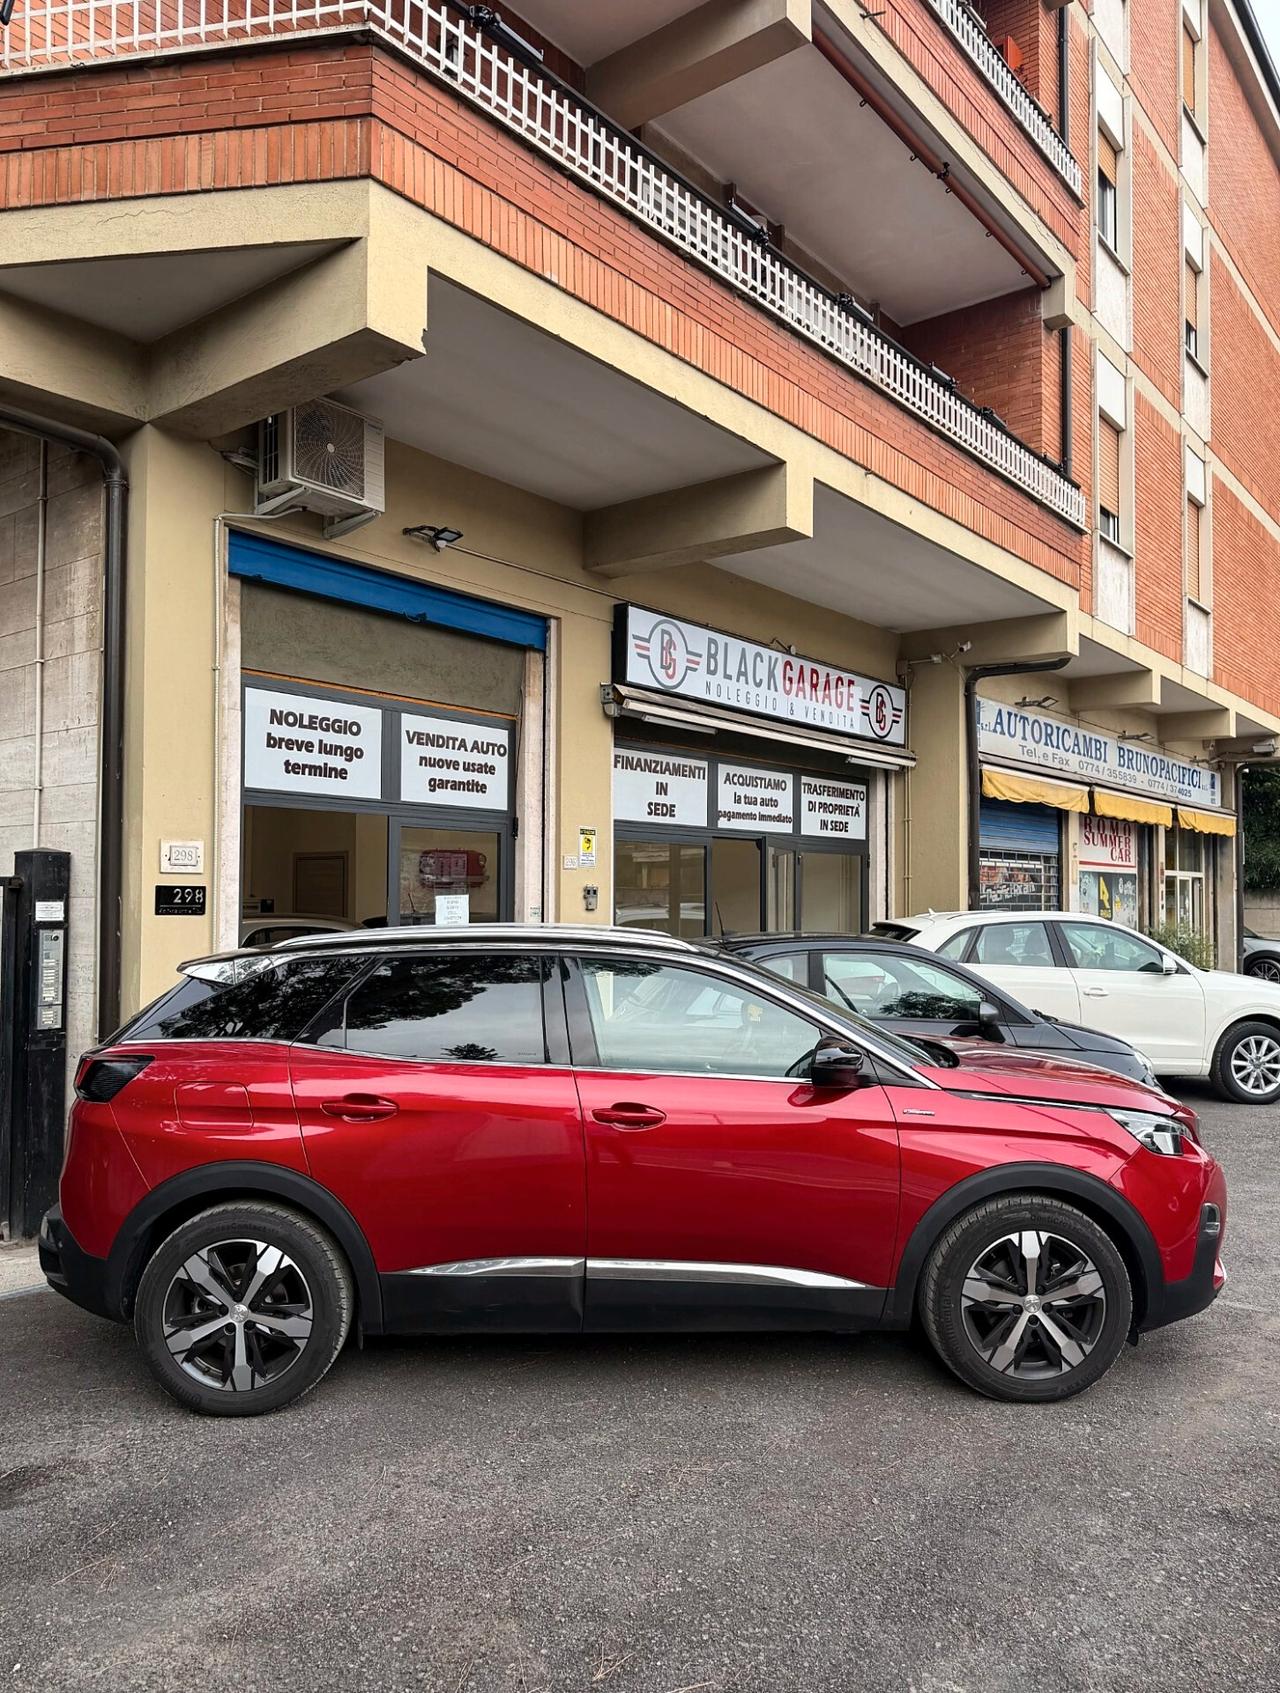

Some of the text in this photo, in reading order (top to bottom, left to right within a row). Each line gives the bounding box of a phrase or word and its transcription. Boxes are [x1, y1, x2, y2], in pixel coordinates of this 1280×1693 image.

[705, 681, 855, 729] NOLEGGIO & VENDITA
[269, 708, 361, 737] NOLEGGIO
[405, 729, 508, 757] VENDITA AUTO
[993, 708, 1108, 763] AUTORICAMBI
[265, 732, 364, 763] breve lungo
[419, 753, 496, 776] nuove usate
[614, 754, 707, 781] FINANZIAMENTI
[1042, 752, 1049, 761] e
[1052, 752, 1070, 767] Fax
[283, 759, 348, 780] termine
[428, 775, 488, 795] garantite
[655, 781, 668, 797] IN
[723, 772, 787, 792] ACQUISTIAMO
[733, 791, 779, 809] la tua auto
[802, 782, 865, 802] TRASFERIMENTO
[647, 801, 676, 818] SEDE
[718, 809, 793, 824] pagamento immediato
[808, 800, 861, 818] DI PROPRIETÀ
[820, 818, 849, 833] IN SEDE
[1083, 831, 1131, 849] SUMMER
[174, 849, 193, 862] 298
[1110, 847, 1131, 863] CAR
[173, 888, 204, 903] 298
